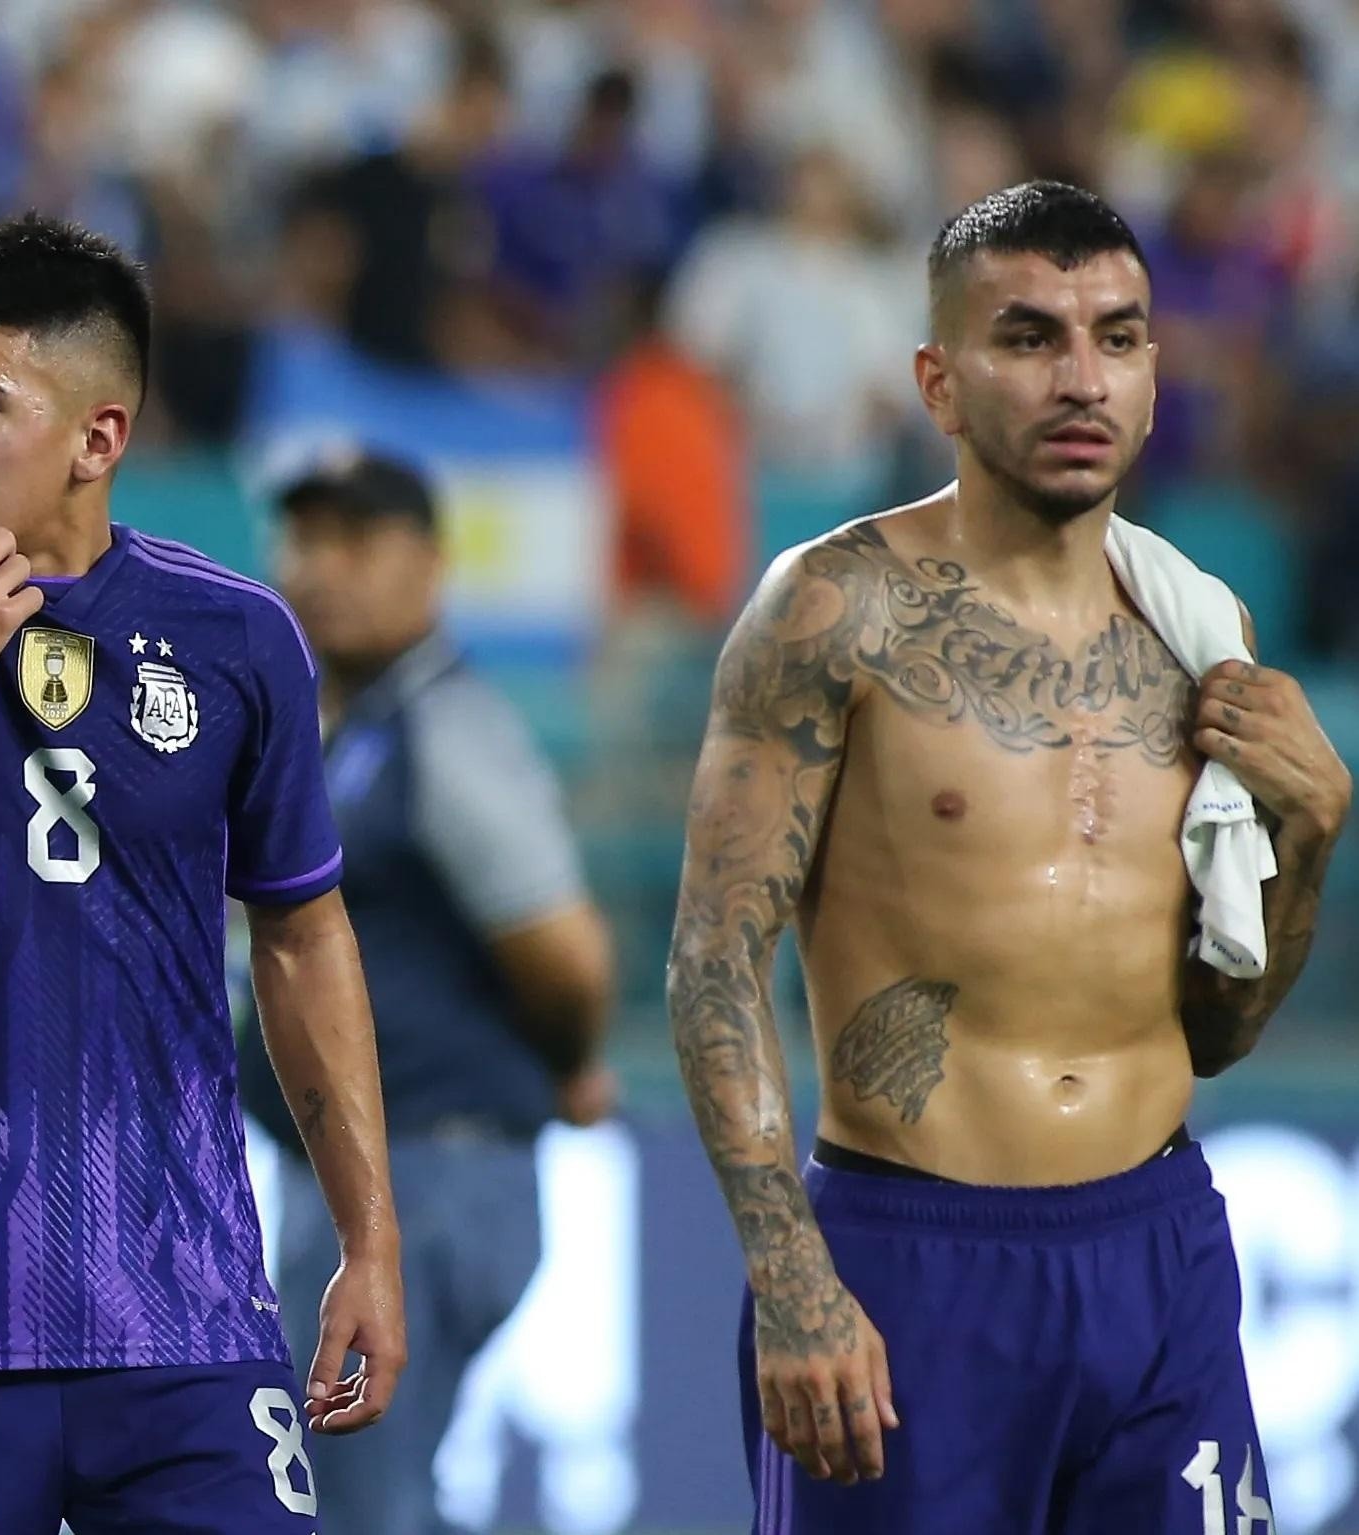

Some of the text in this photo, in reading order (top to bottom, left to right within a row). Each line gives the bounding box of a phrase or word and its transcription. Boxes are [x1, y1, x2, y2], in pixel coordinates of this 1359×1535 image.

[146, 686, 184, 726] AFA
[24, 748, 100, 883] 8
[248, 1388, 318, 1517] 8
